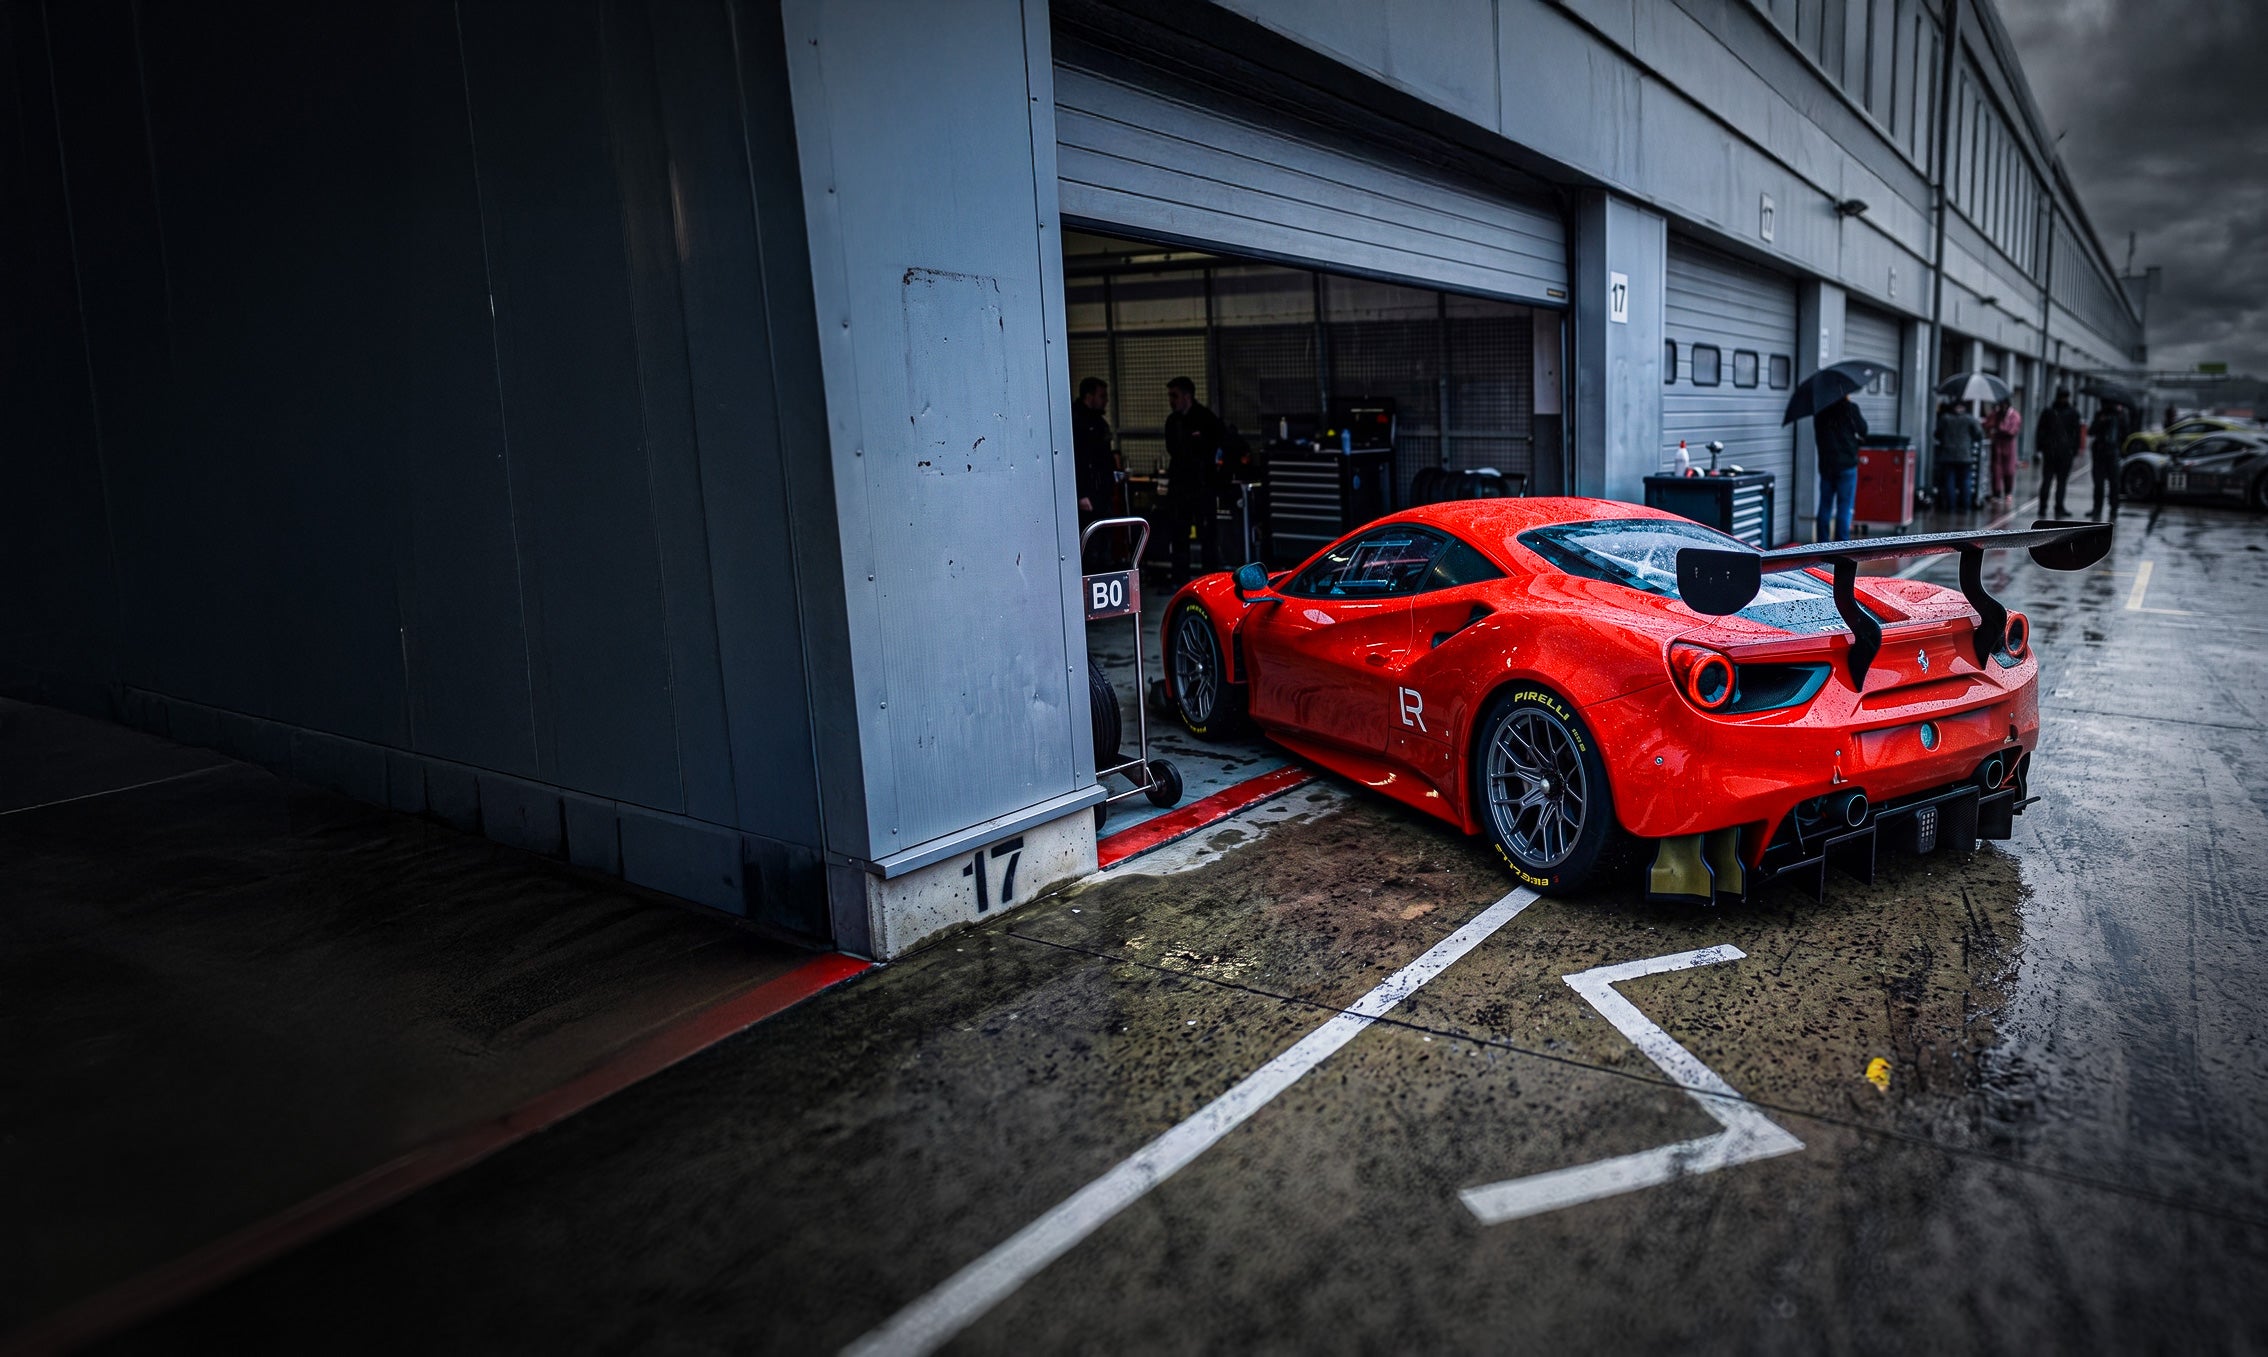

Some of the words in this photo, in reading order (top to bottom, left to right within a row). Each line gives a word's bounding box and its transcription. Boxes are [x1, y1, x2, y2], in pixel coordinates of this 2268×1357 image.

[1612, 283, 1626, 313] 17
[1514, 691, 1570, 721] PIRELLI
[963, 836, 1024, 913] 17
